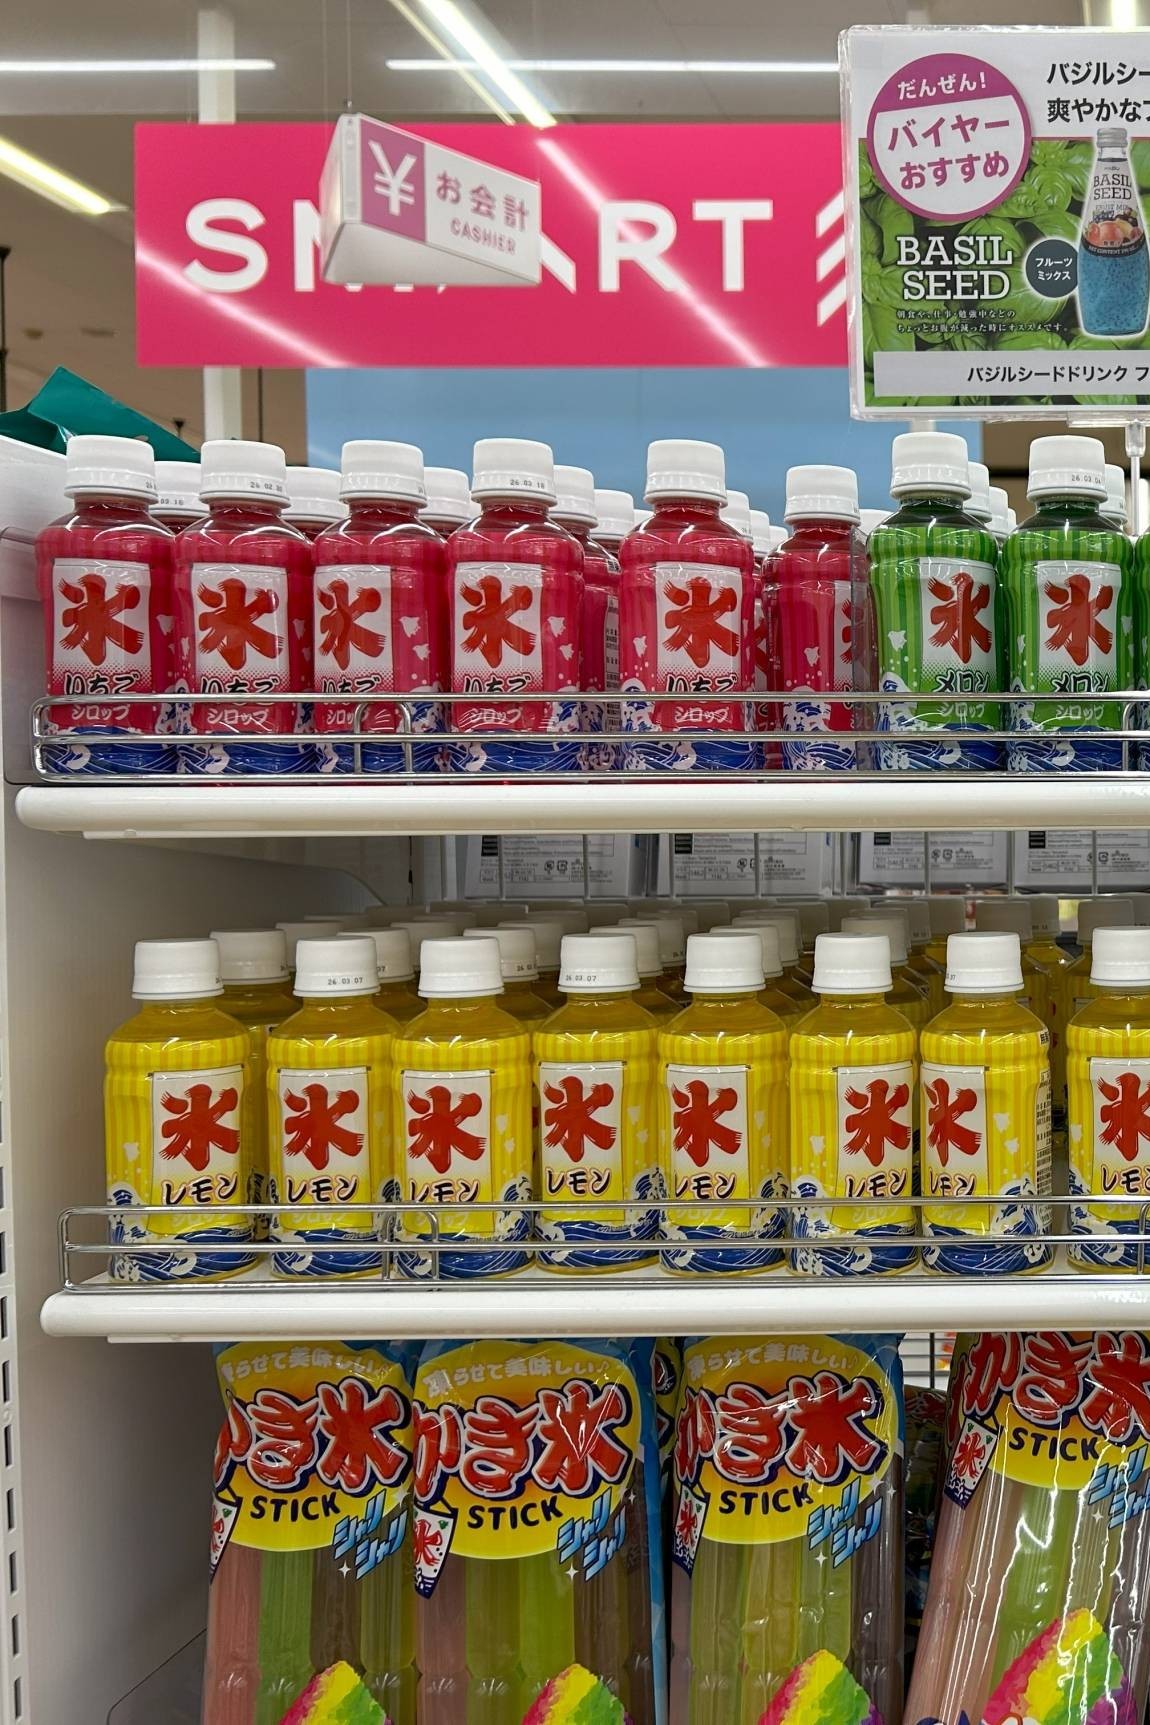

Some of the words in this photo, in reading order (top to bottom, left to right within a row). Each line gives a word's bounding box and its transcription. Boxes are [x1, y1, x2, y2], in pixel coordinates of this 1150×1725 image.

[888, 114, 1009, 151] バイヤー
[900, 151, 1009, 190] おすすめ
[1094, 174, 1132, 187] BASIL
[435, 170, 529, 231] お会計
[1094, 187, 1132, 200] SEED
[184, 199, 773, 294] SRT
[451, 218, 516, 255] CASHIER
[897, 236, 1013, 265] BASIL
[1035, 256, 1073, 268] フルーツ
[1037, 269, 1072, 281] ミックス
[903, 271, 1011, 300] SEED
[967, 364, 1128, 382] バジルシードドリンク
[59, 574, 145, 666] 氷
[199, 578, 285, 670] 氷
[318, 579, 386, 670] 氷
[461, 575, 536, 668] 氷
[663, 576, 740, 668] 氷
[928, 572, 992, 664] 氷
[1045, 574, 1113, 665] 氷
[71, 704, 130, 721] シロップ
[207, 708, 270, 725] シロップ
[936, 702, 986, 718] シロップ
[1055, 704, 1105, 720] シロップ
[159, 1083, 241, 1172] 氷
[283, 1083, 364, 1170] 氷
[407, 1085, 487, 1174] 氷
[543, 1076, 617, 1162] 氷
[672, 1079, 743, 1167] 氷
[843, 1079, 911, 1167] 氷
[924, 1077, 982, 1167] 氷
[161, 1173, 238, 1205] レモン
[284, 1177, 359, 1204] レモン
[408, 1179, 481, 1203] レモン
[544, 1167, 612, 1197] レモン
[674, 1172, 737, 1200] レモン
[845, 1168, 908, 1199] レモン
[674, 1370, 884, 1486] かき氷
[1008, 1429, 1106, 1462] STICK
[951, 1440, 986, 1480] 氷
[251, 1491, 341, 1522] STICK
[467, 1497, 563, 1529] STICK
[720, 1481, 813, 1516] STICK
[807, 1477, 862, 1551] シャリ
[332, 1488, 387, 1560] シャリ
[557, 1487, 613, 1565] シャリ
